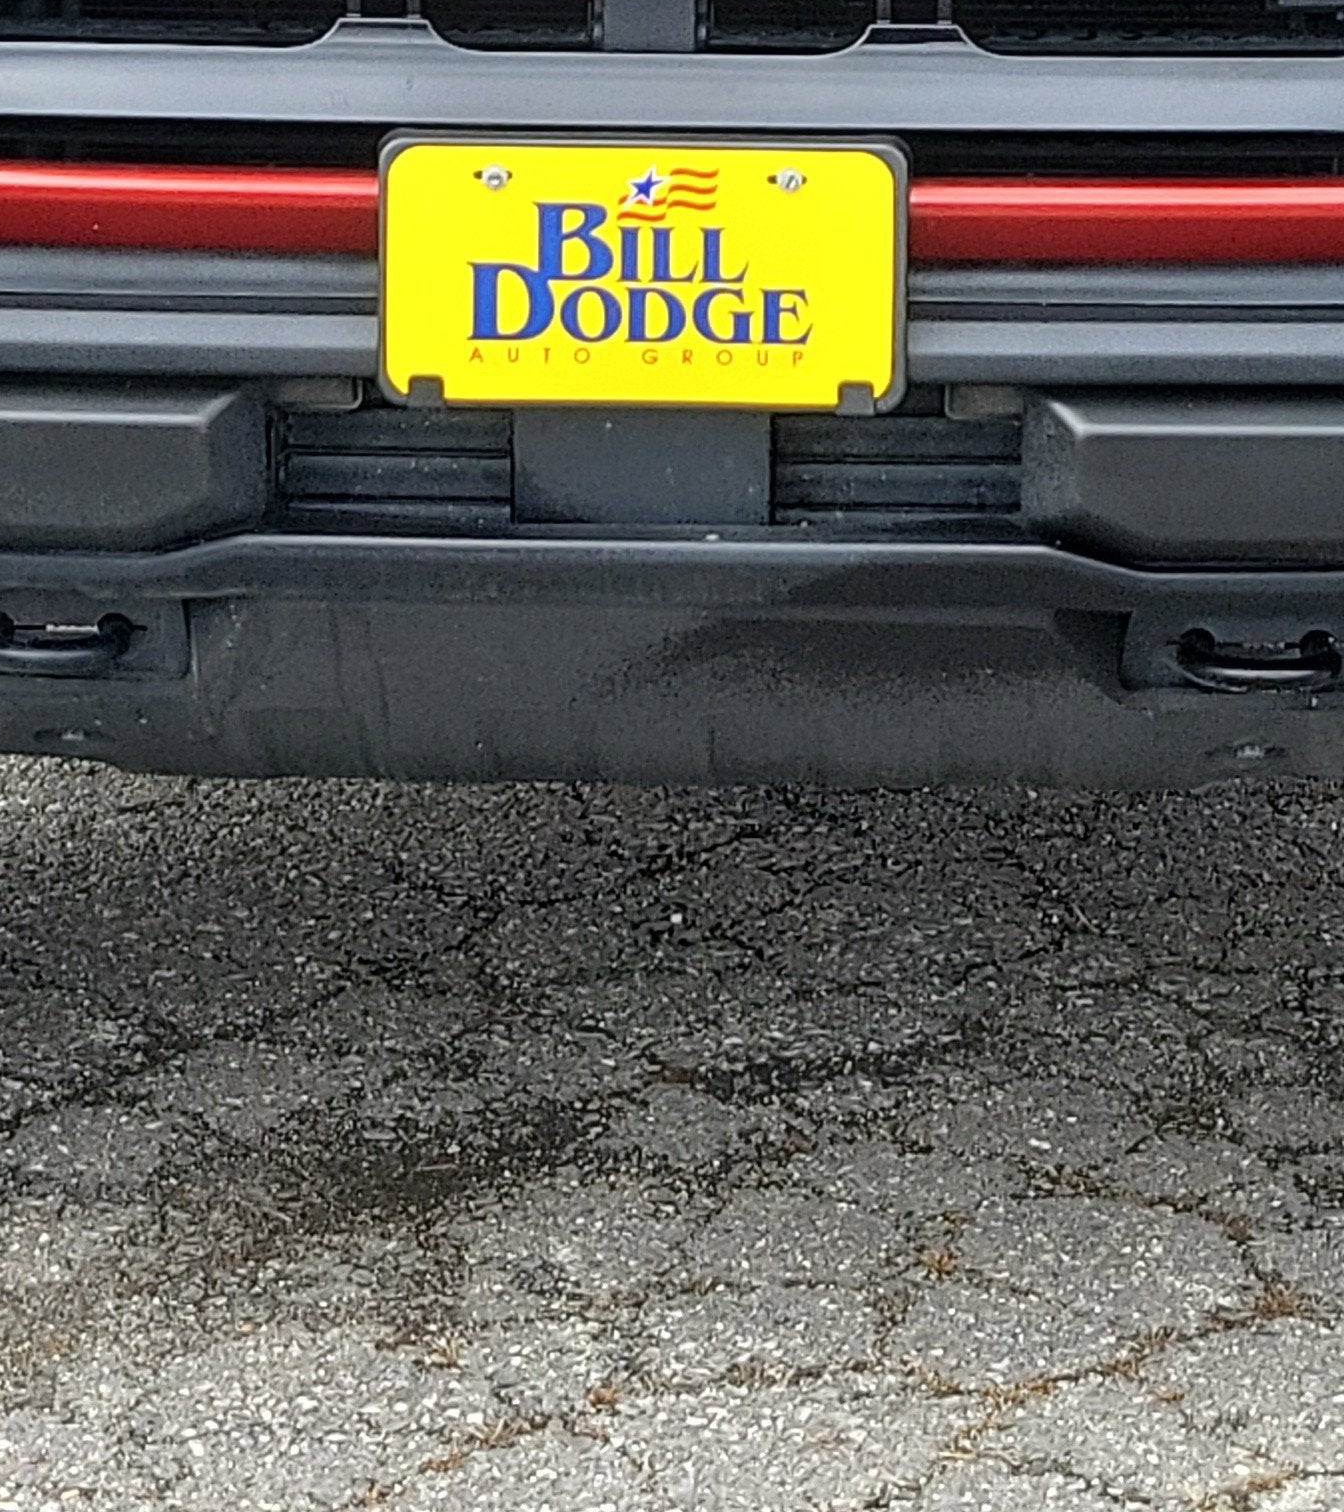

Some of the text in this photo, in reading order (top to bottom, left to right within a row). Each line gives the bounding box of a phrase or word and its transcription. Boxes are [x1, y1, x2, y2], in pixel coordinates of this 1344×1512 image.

[532, 201, 749, 283] BILL
[466, 261, 813, 345] DODGE
[468, 346, 806, 368] AUTO GROUP
